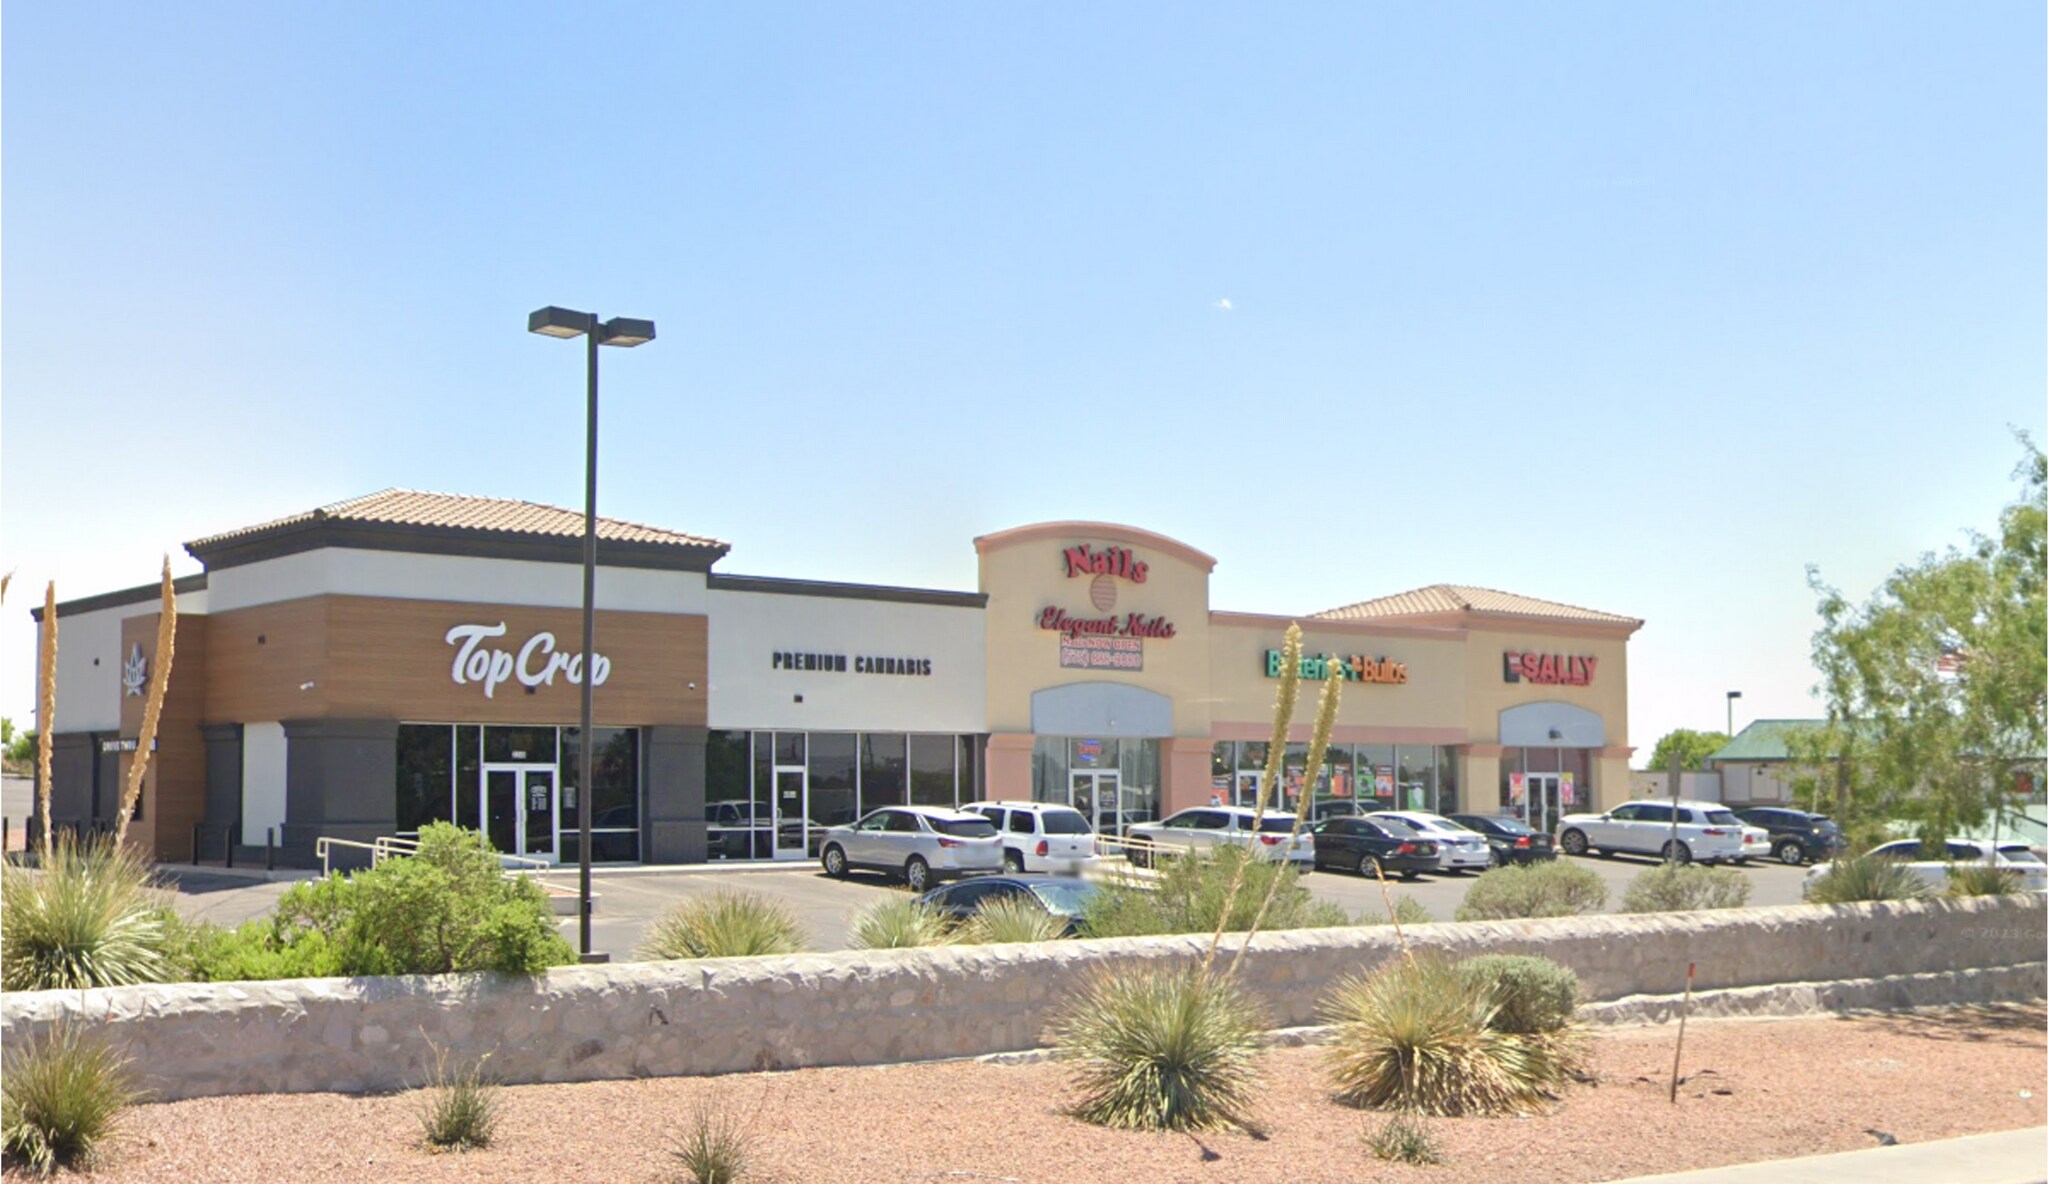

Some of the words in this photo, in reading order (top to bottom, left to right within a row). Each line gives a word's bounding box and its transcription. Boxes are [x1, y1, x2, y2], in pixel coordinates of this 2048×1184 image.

[1063, 544, 1148, 583] Nails
[1040, 606, 1119, 638] Elegant
[1119, 613, 1176, 639] Nails
[445, 621, 513, 698] Top
[773, 652, 847, 672] PREMIUM
[855, 656, 931, 676] CANNABIS
[1362, 655, 1409, 684] Bulbs
[1521, 652, 1598, 683] SALLY
